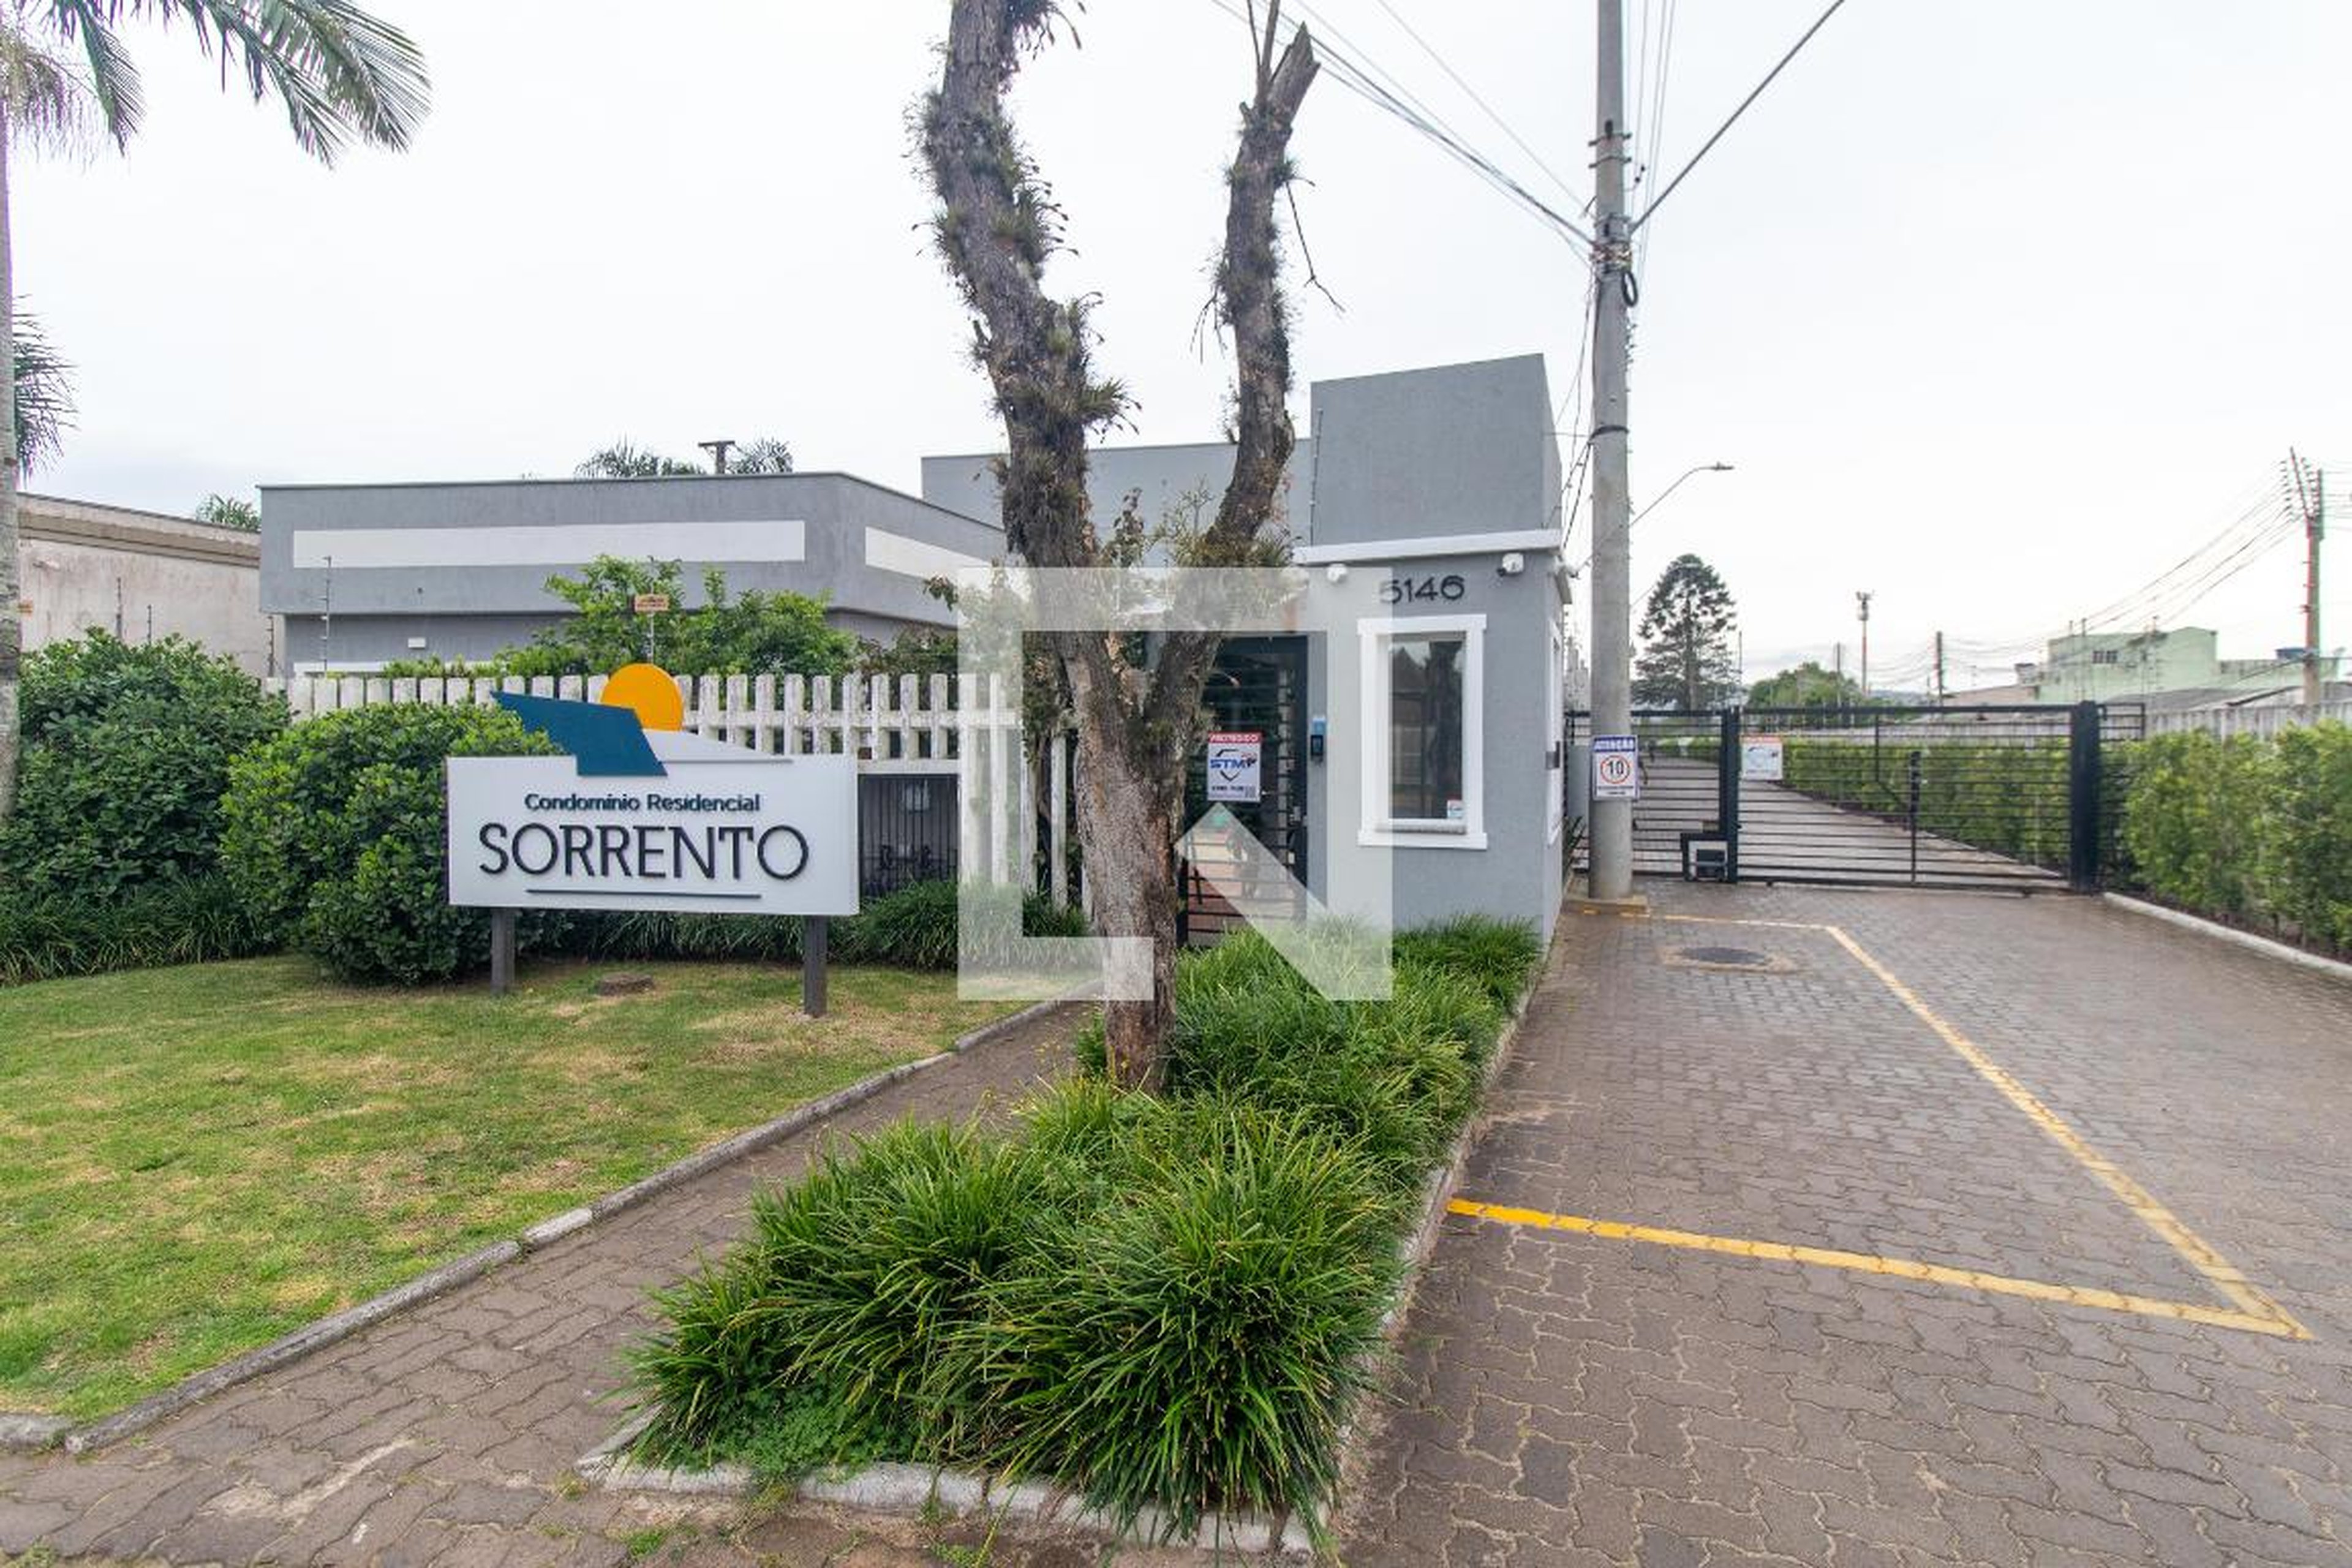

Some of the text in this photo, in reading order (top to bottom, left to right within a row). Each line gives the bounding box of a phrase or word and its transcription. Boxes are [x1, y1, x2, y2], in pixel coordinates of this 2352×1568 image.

[1379, 575, 1465, 604] 5146
[1607, 760, 1624, 775] 10
[647, 794, 761, 812] Residencial
[479, 823, 809, 881] SORRENTO
